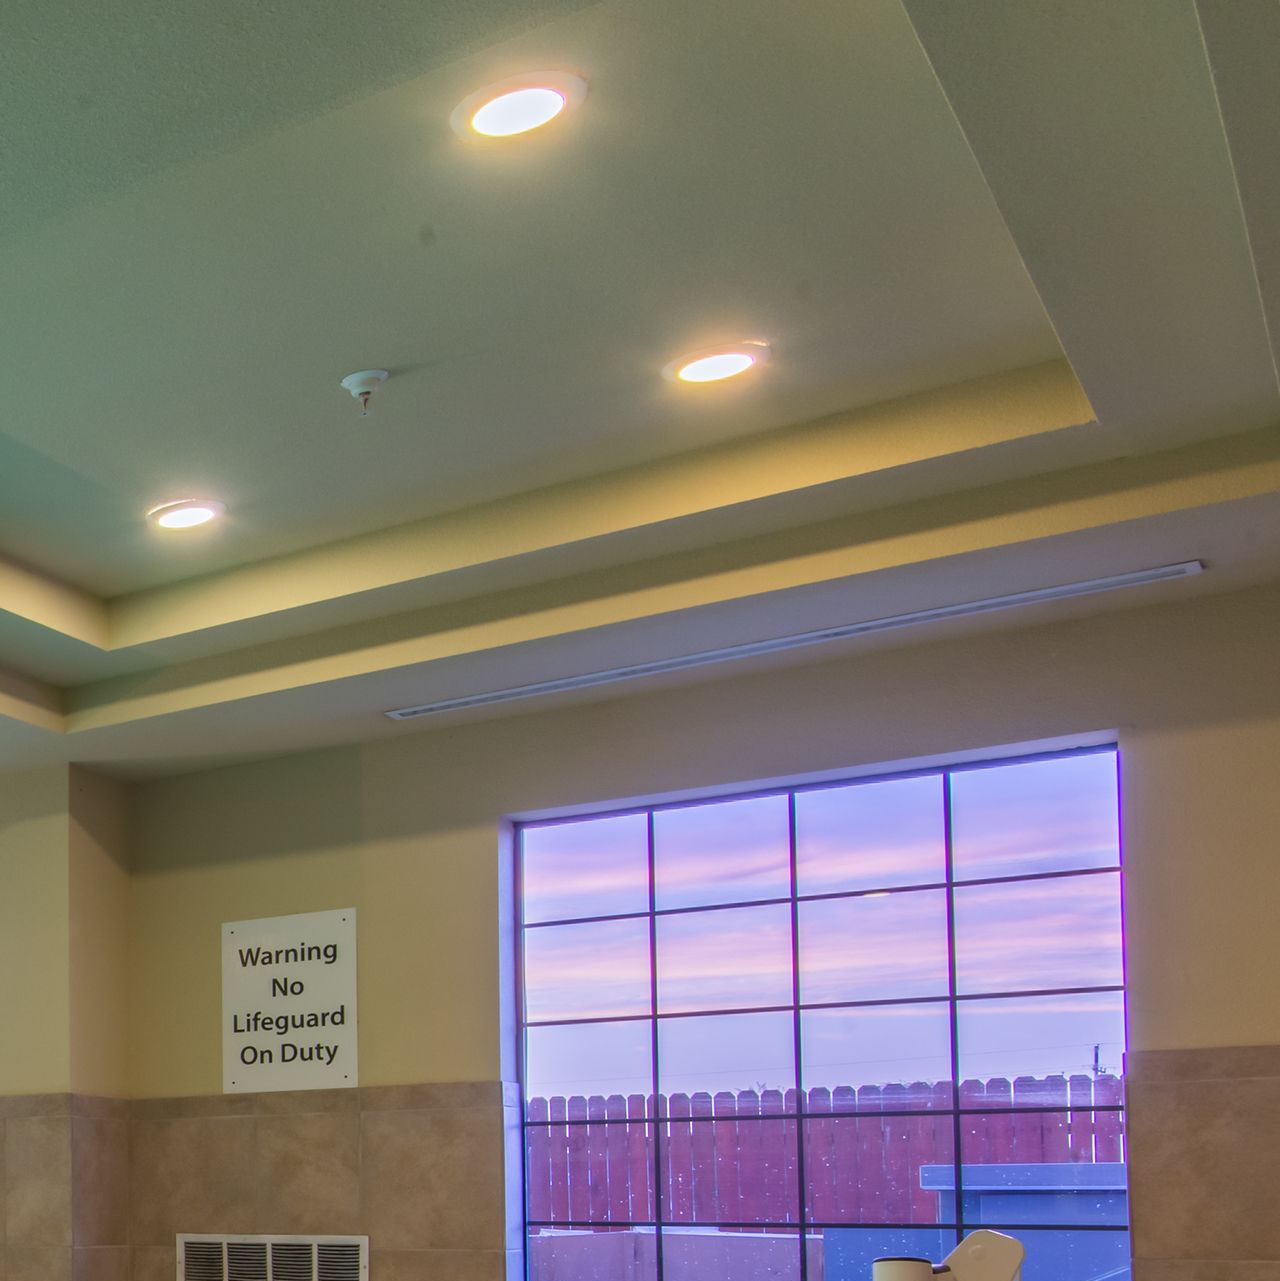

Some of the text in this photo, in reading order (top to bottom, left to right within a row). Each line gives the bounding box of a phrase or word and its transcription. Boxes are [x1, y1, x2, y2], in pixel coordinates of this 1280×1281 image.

[238, 942, 338, 967] Warning
[271, 977, 305, 997] No
[233, 1004, 345, 1035] Lifeguard
[240, 1043, 339, 1066] On Duty
